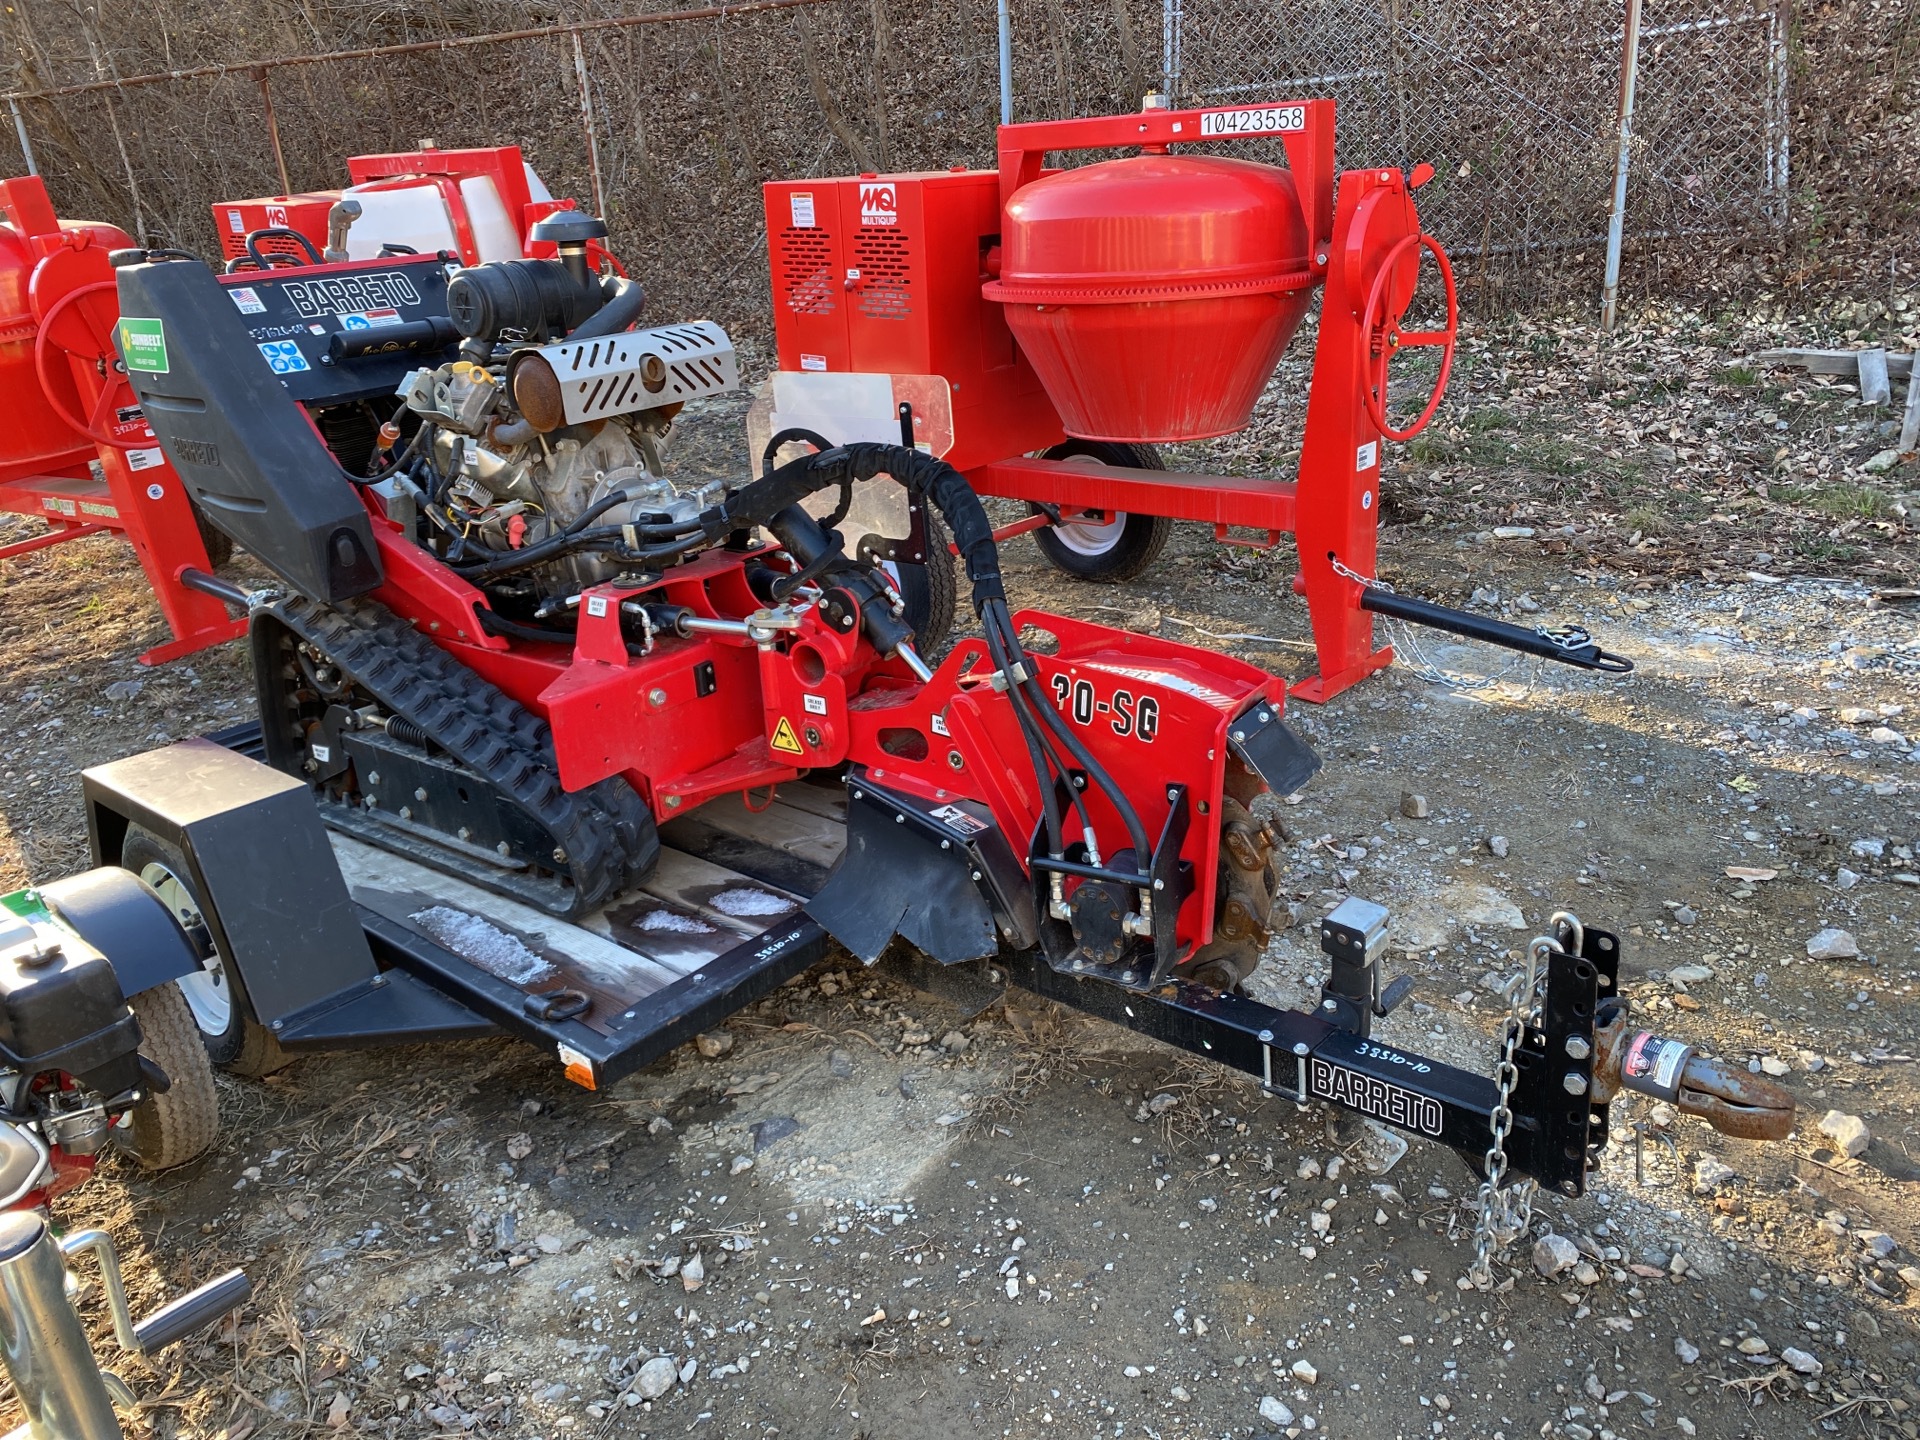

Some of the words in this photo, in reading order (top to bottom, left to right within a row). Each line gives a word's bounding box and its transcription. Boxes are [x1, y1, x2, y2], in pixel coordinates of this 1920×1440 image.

[1204, 108, 1303, 133] 10423558
[861, 187, 897, 212] MQ
[861, 216, 898, 226] MULTIQUIP
[281, 271, 421, 319] BARRETO
[131, 333, 162, 347] SUNBELT
[171, 436, 220, 468] BARRETO
[1354, 1042, 1432, 1074] 38510-10
[1311, 1058, 1443, 1137] BARRETO
